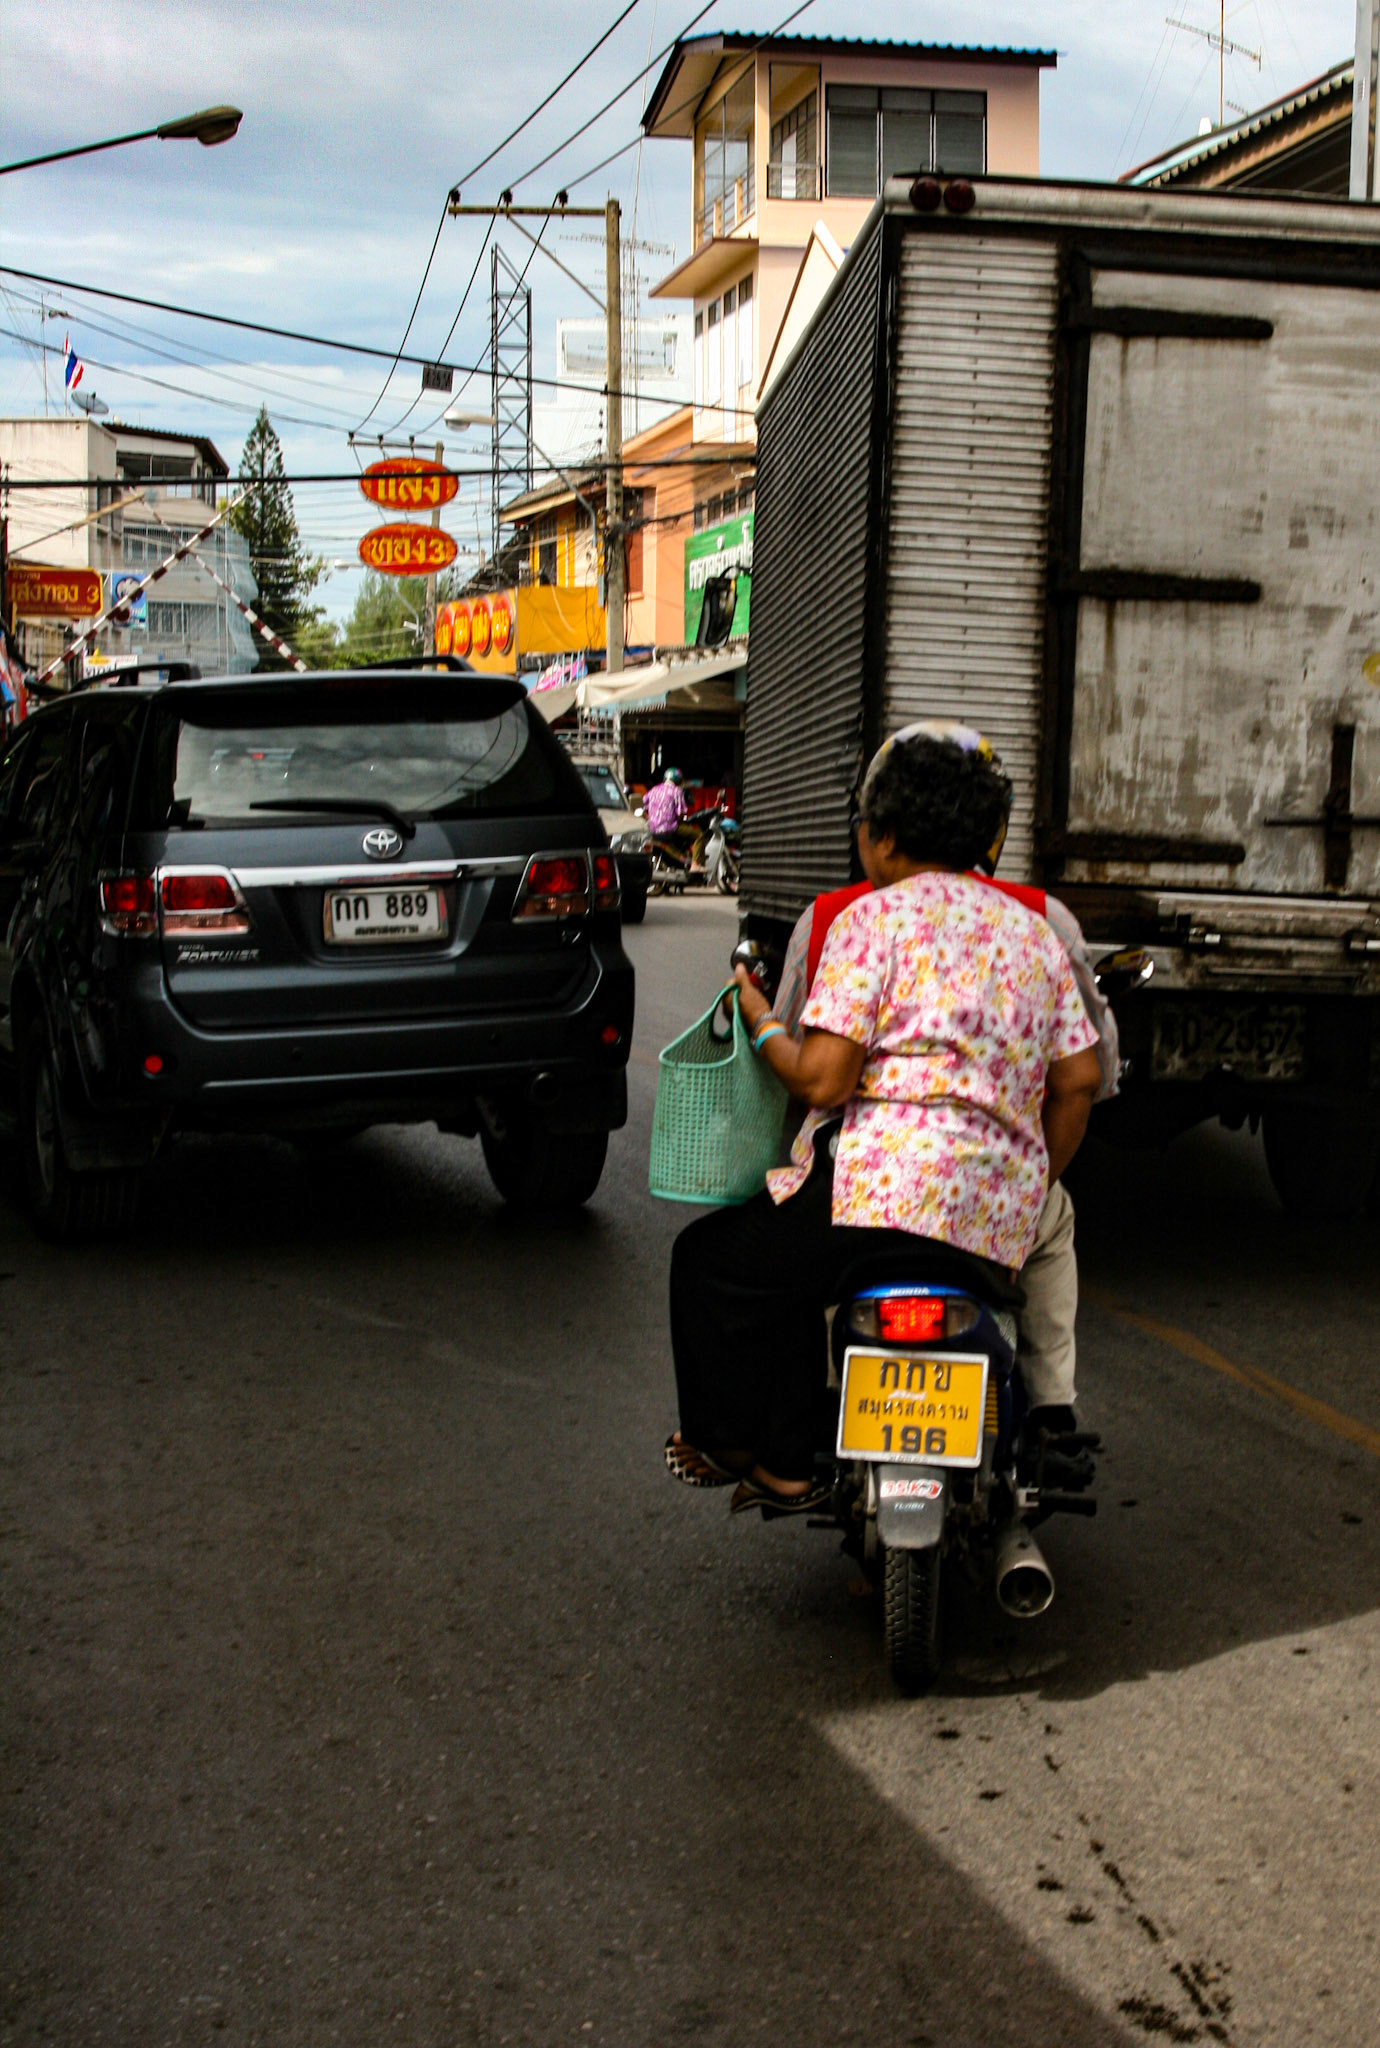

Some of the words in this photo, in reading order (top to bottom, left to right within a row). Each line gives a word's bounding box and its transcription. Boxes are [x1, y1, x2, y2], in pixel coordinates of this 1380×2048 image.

[86, 584, 99, 604] 3
[335, 896, 370, 921] กก
[385, 893, 428, 918] 889
[177, 949, 260, 963] FORTUNER
[880, 1360, 952, 1391] กกข
[858, 1397, 969, 1420] สมุทรสงคราม
[881, 1424, 946, 1455] 196
